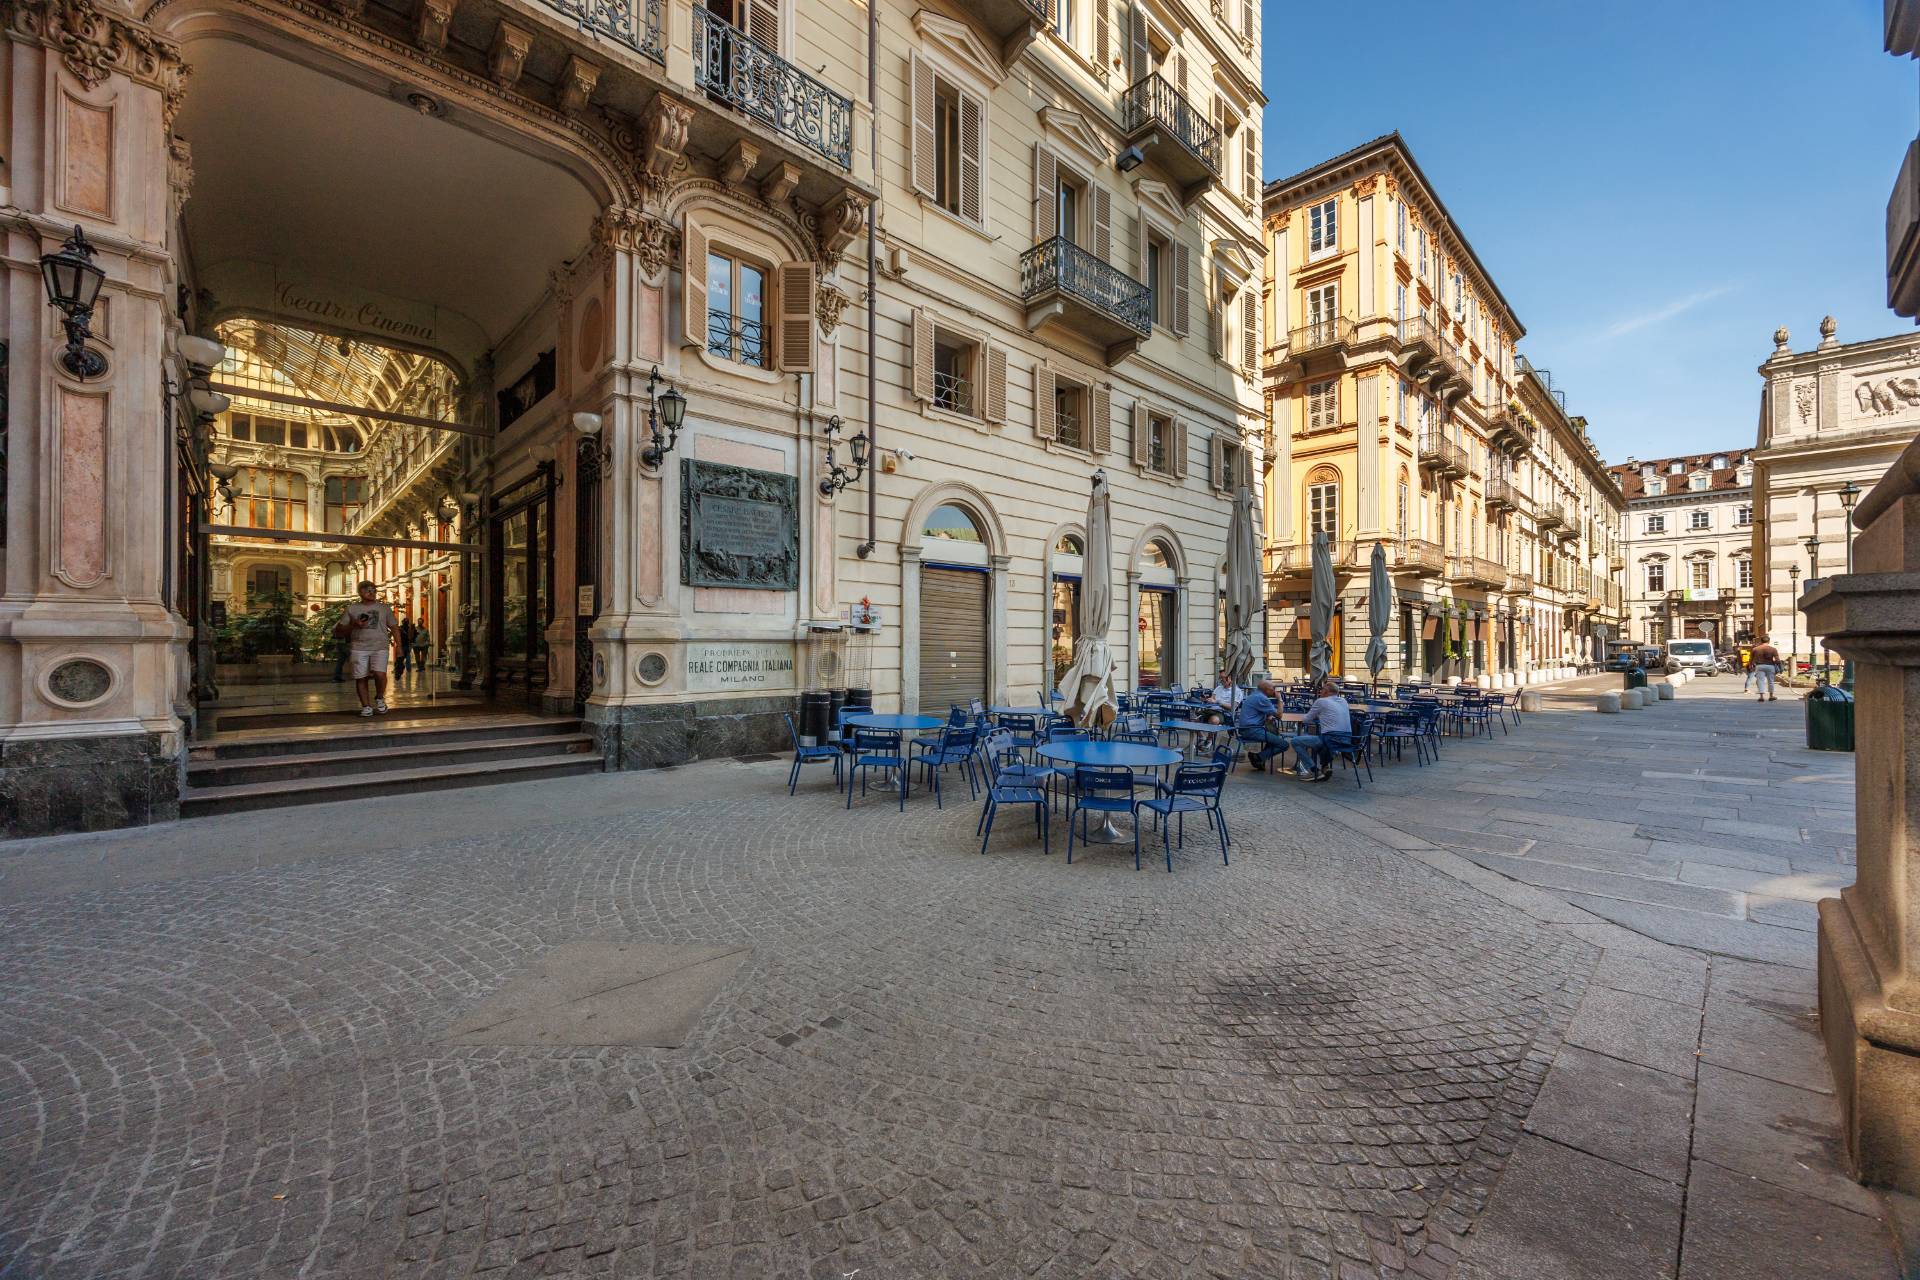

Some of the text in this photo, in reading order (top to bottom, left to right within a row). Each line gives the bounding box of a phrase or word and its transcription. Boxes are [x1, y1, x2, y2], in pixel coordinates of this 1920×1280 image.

[358, 302, 434, 340] Cinema
[688, 659, 793, 674] REALE COMPAGNIA ITALIANA
[720, 675, 765, 683] MILANO
